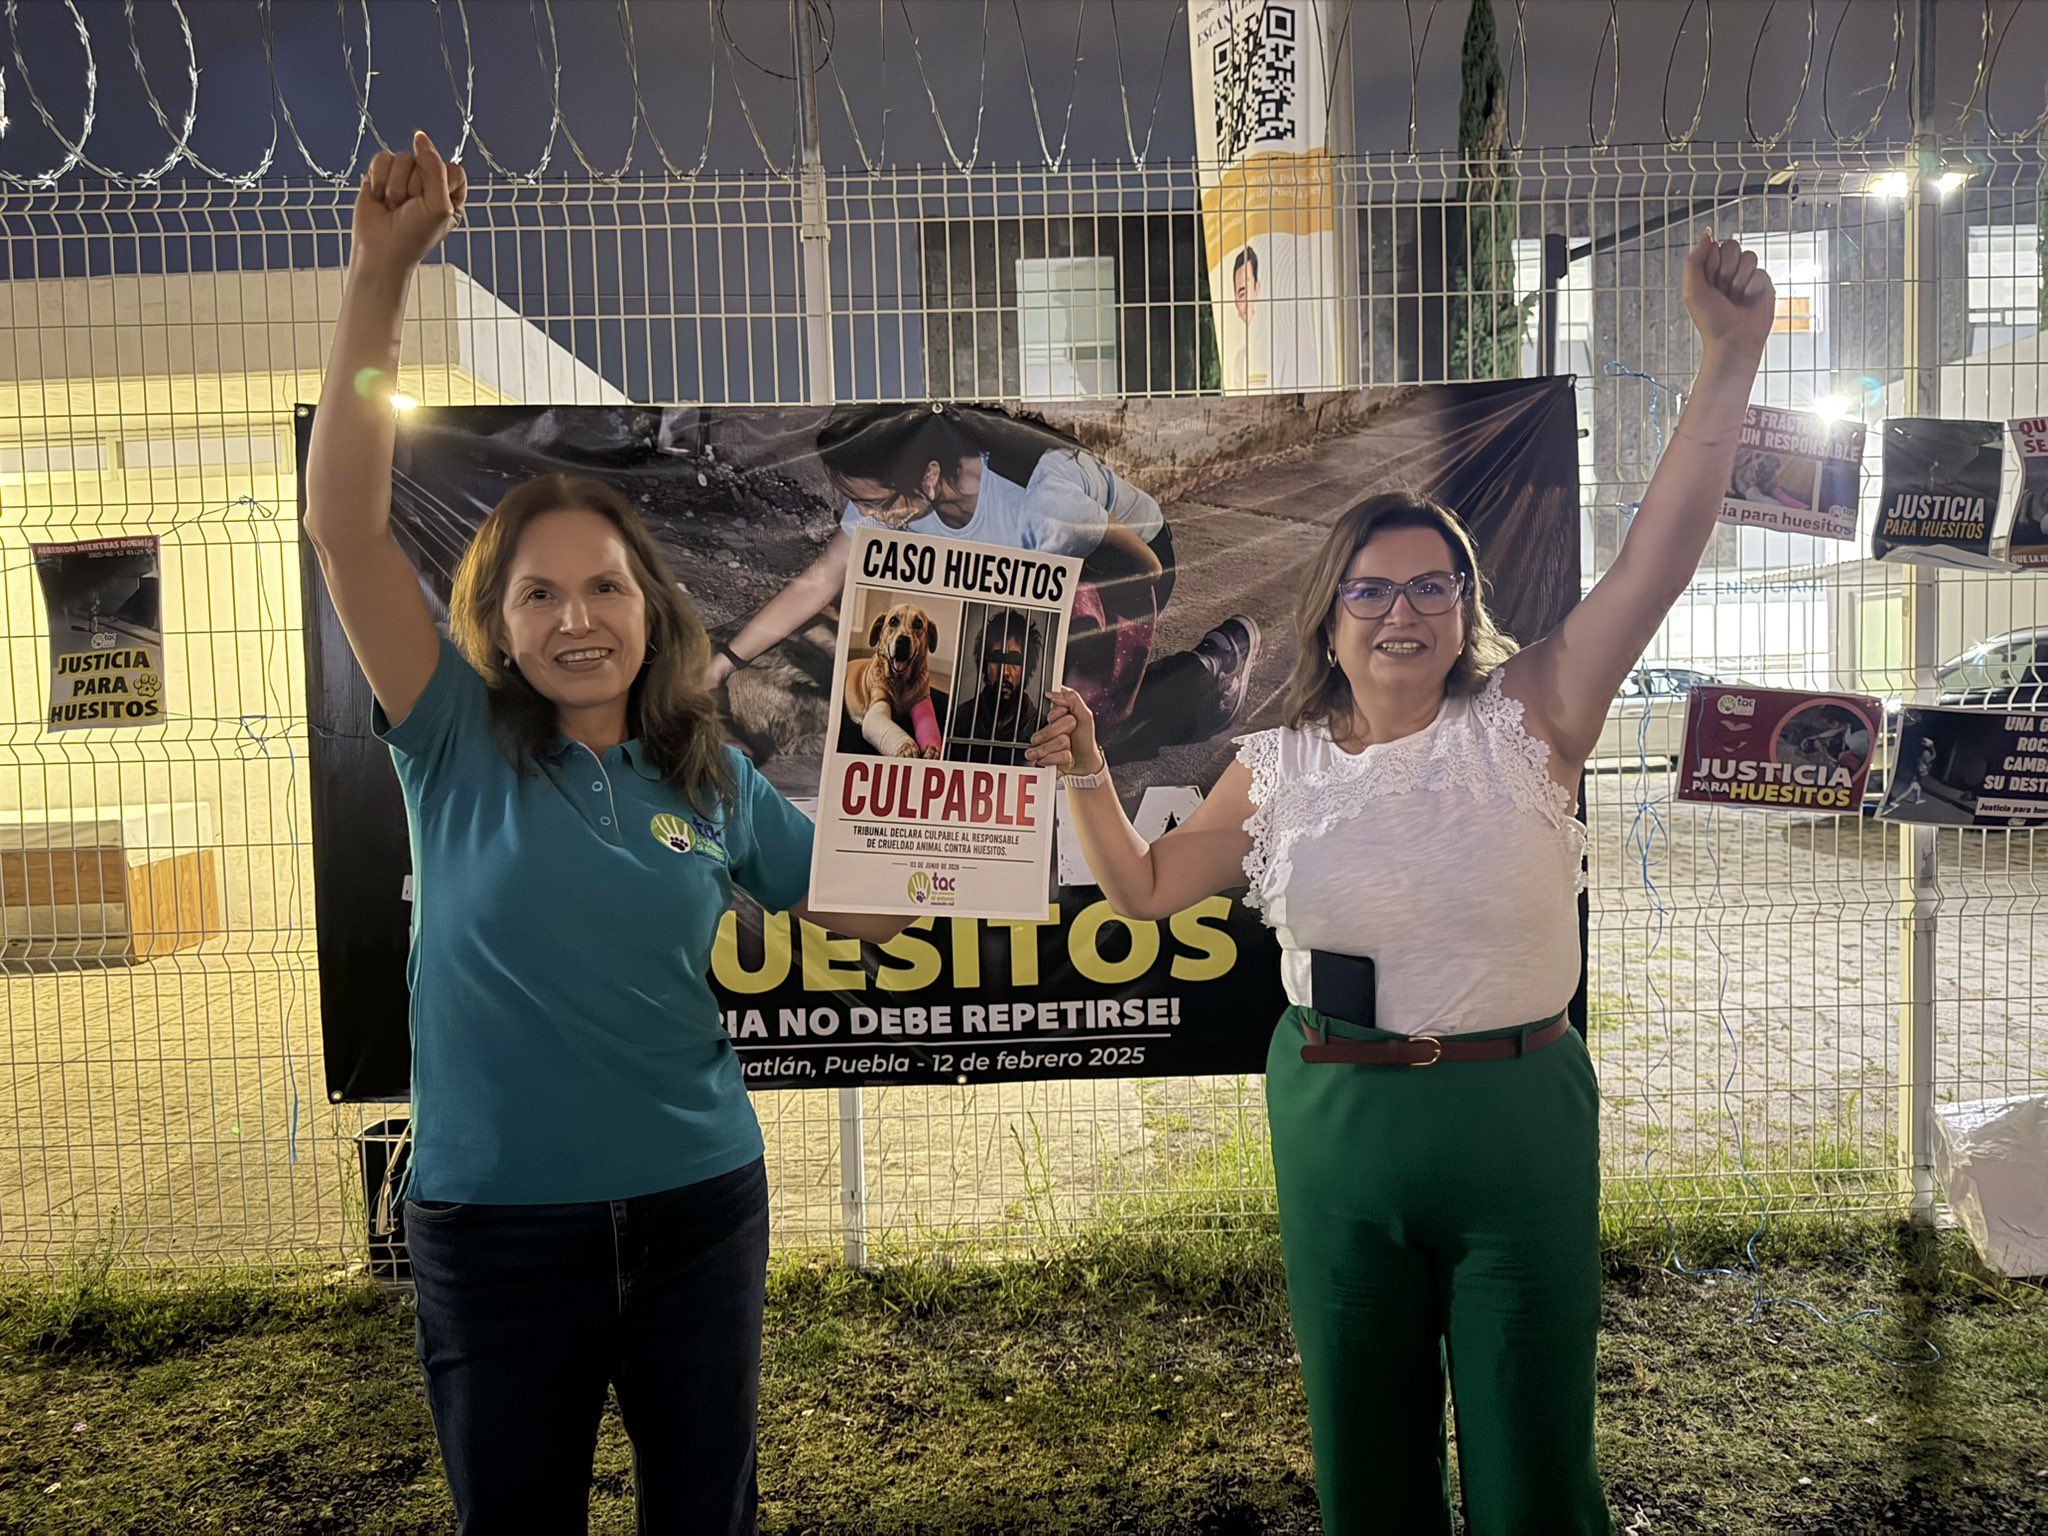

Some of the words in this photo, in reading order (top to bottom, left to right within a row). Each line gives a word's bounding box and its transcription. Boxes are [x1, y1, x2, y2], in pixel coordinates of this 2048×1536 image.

[2018, 419, 2048, 438] QU
[1764, 431, 1860, 463] RESPONSABLE
[1887, 494, 1985, 522] JUSTICIA
[1740, 509, 1778, 524] para
[1781, 511, 1852, 536] huesitos
[1883, 518, 1917, 537] PARA
[1920, 520, 1985, 539] HUESITOS
[37, 544, 76, 554] AGREDIDO
[77, 540, 119, 552] MIENTRAS
[863, 539, 936, 585] CASO
[943, 549, 1067, 602] HUESITOS
[58, 651, 150, 675] JUSTICIA
[73, 676, 129, 697] PARA
[51, 700, 159, 723] HUESITOS
[2004, 716, 2034, 732] UNA
[1692, 758, 1853, 788] JUSTICIA
[1983, 775, 2005, 790] SU
[841, 761, 1038, 827] CULPABLE
[1692, 780, 1730, 793] PARA
[1729, 781, 1852, 808] HUESITOS
[1979, 803, 2011, 813] Justicia
[2013, 804, 2031, 814] para
[853, 825, 888, 837] TRIBUNAL
[890, 827, 922, 839] DECLARA
[924, 829, 960, 842] CULPABLE
[961, 832, 970, 842] AL
[971, 832, 1020, 845] RESPONSABLE
[866, 838, 876, 848] DE
[877, 839, 915, 851] CRUELDAD
[916, 841, 942, 852] ANIMAL
[944, 843, 972, 854] CONTRA
[973, 845, 1007, 856] HUESITOS.
[941, 862, 947, 870] DE
[932, 871, 956, 892] tac
[710, 896, 1238, 994] UESITOS
[778, 1007, 840, 1037] NO
[850, 1006, 952, 1036] DEBE
[962, 997, 1181, 1034] REPETIRSE!
[824, 1054, 910, 1075] Puebla
[932, 1054, 954, 1072] 12
[960, 1052, 990, 1071] de
[996, 1050, 1083, 1070] febrero
[1088, 1047, 1146, 1067] 2025
